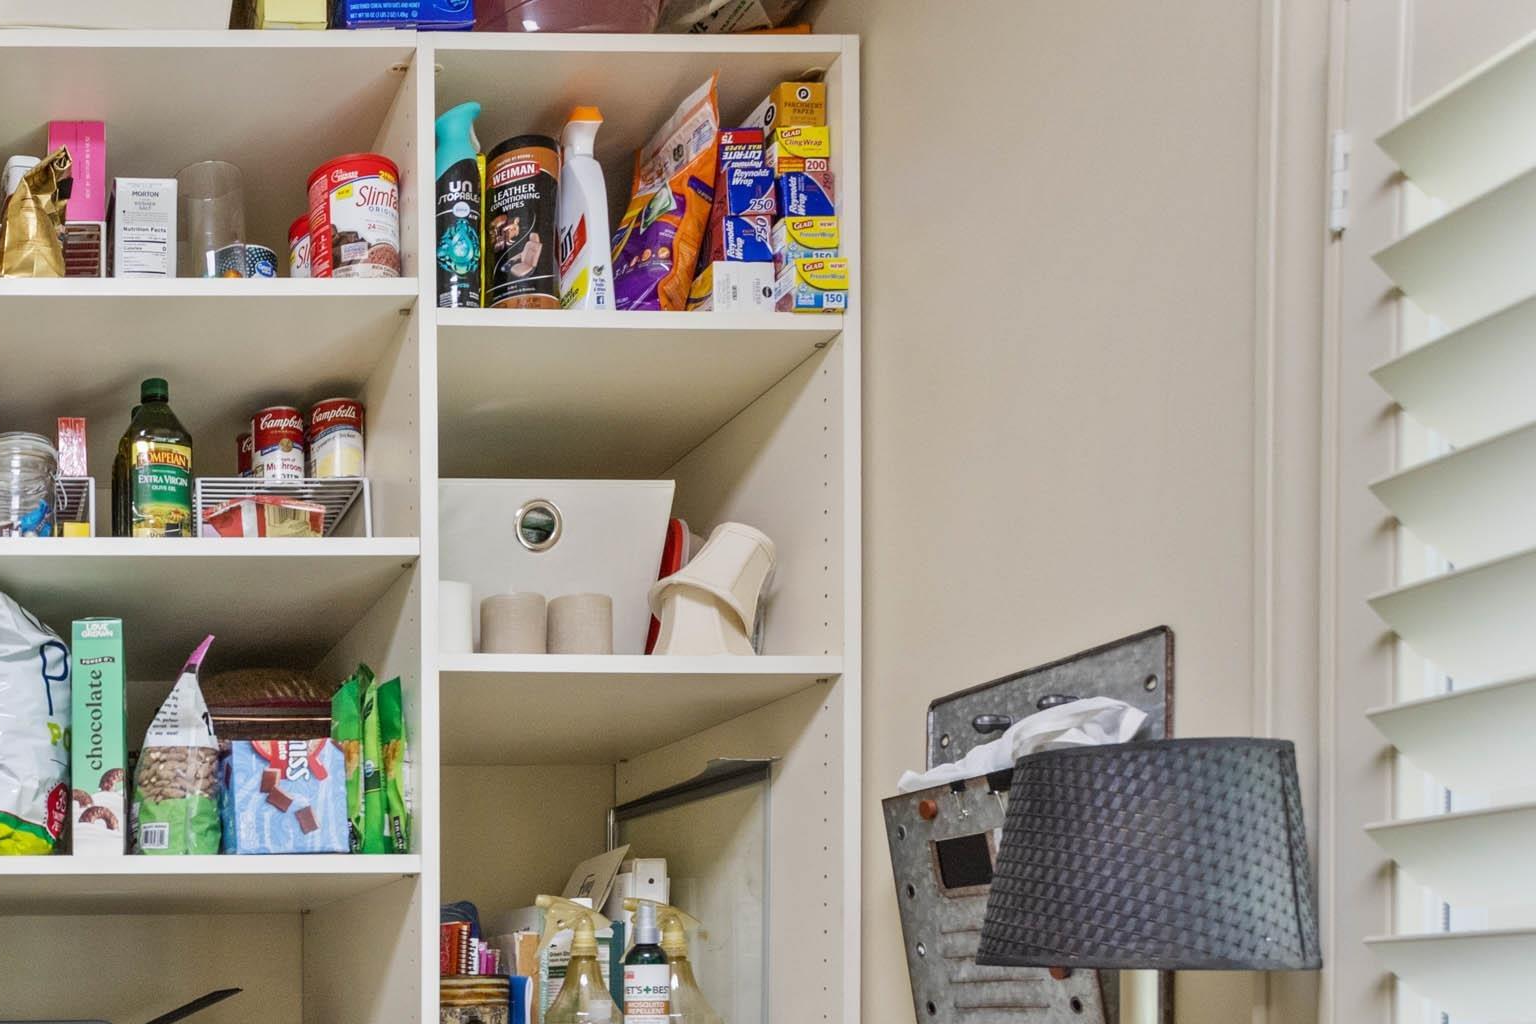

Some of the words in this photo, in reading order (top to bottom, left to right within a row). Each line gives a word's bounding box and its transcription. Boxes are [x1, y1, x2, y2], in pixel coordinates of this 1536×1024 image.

[781, 129, 802, 139] GLAD
[721, 150, 762, 161] CUT-RITE
[806, 159, 826, 171] 200
[491, 162, 537, 187] WEIMAN
[733, 168, 770, 178] Reynolds
[731, 177, 754, 188] Wrap
[131, 190, 160, 198] MORTON
[493, 183, 537, 203] LEATHER
[788, 175, 798, 214] Reynolds
[490, 192, 541, 213] CONDITIONING
[501, 200, 526, 214] WIPES
[749, 199, 774, 211] 250
[796, 192, 808, 216] Wrap
[755, 215, 769, 242] 250
[792, 219, 814, 230] GLAD
[726, 219, 735, 258] Reynolds
[734, 236, 745, 260] Wrap
[803, 262, 824, 271] GLAD
[825, 294, 843, 303] 150
[138, 474, 164, 484] EXTRA
[164, 474, 188, 487] VIRGIN
[85, 623, 109, 631] LOVE
[85, 669, 104, 771] chocolate
[652, 985, 670, 994] BES
